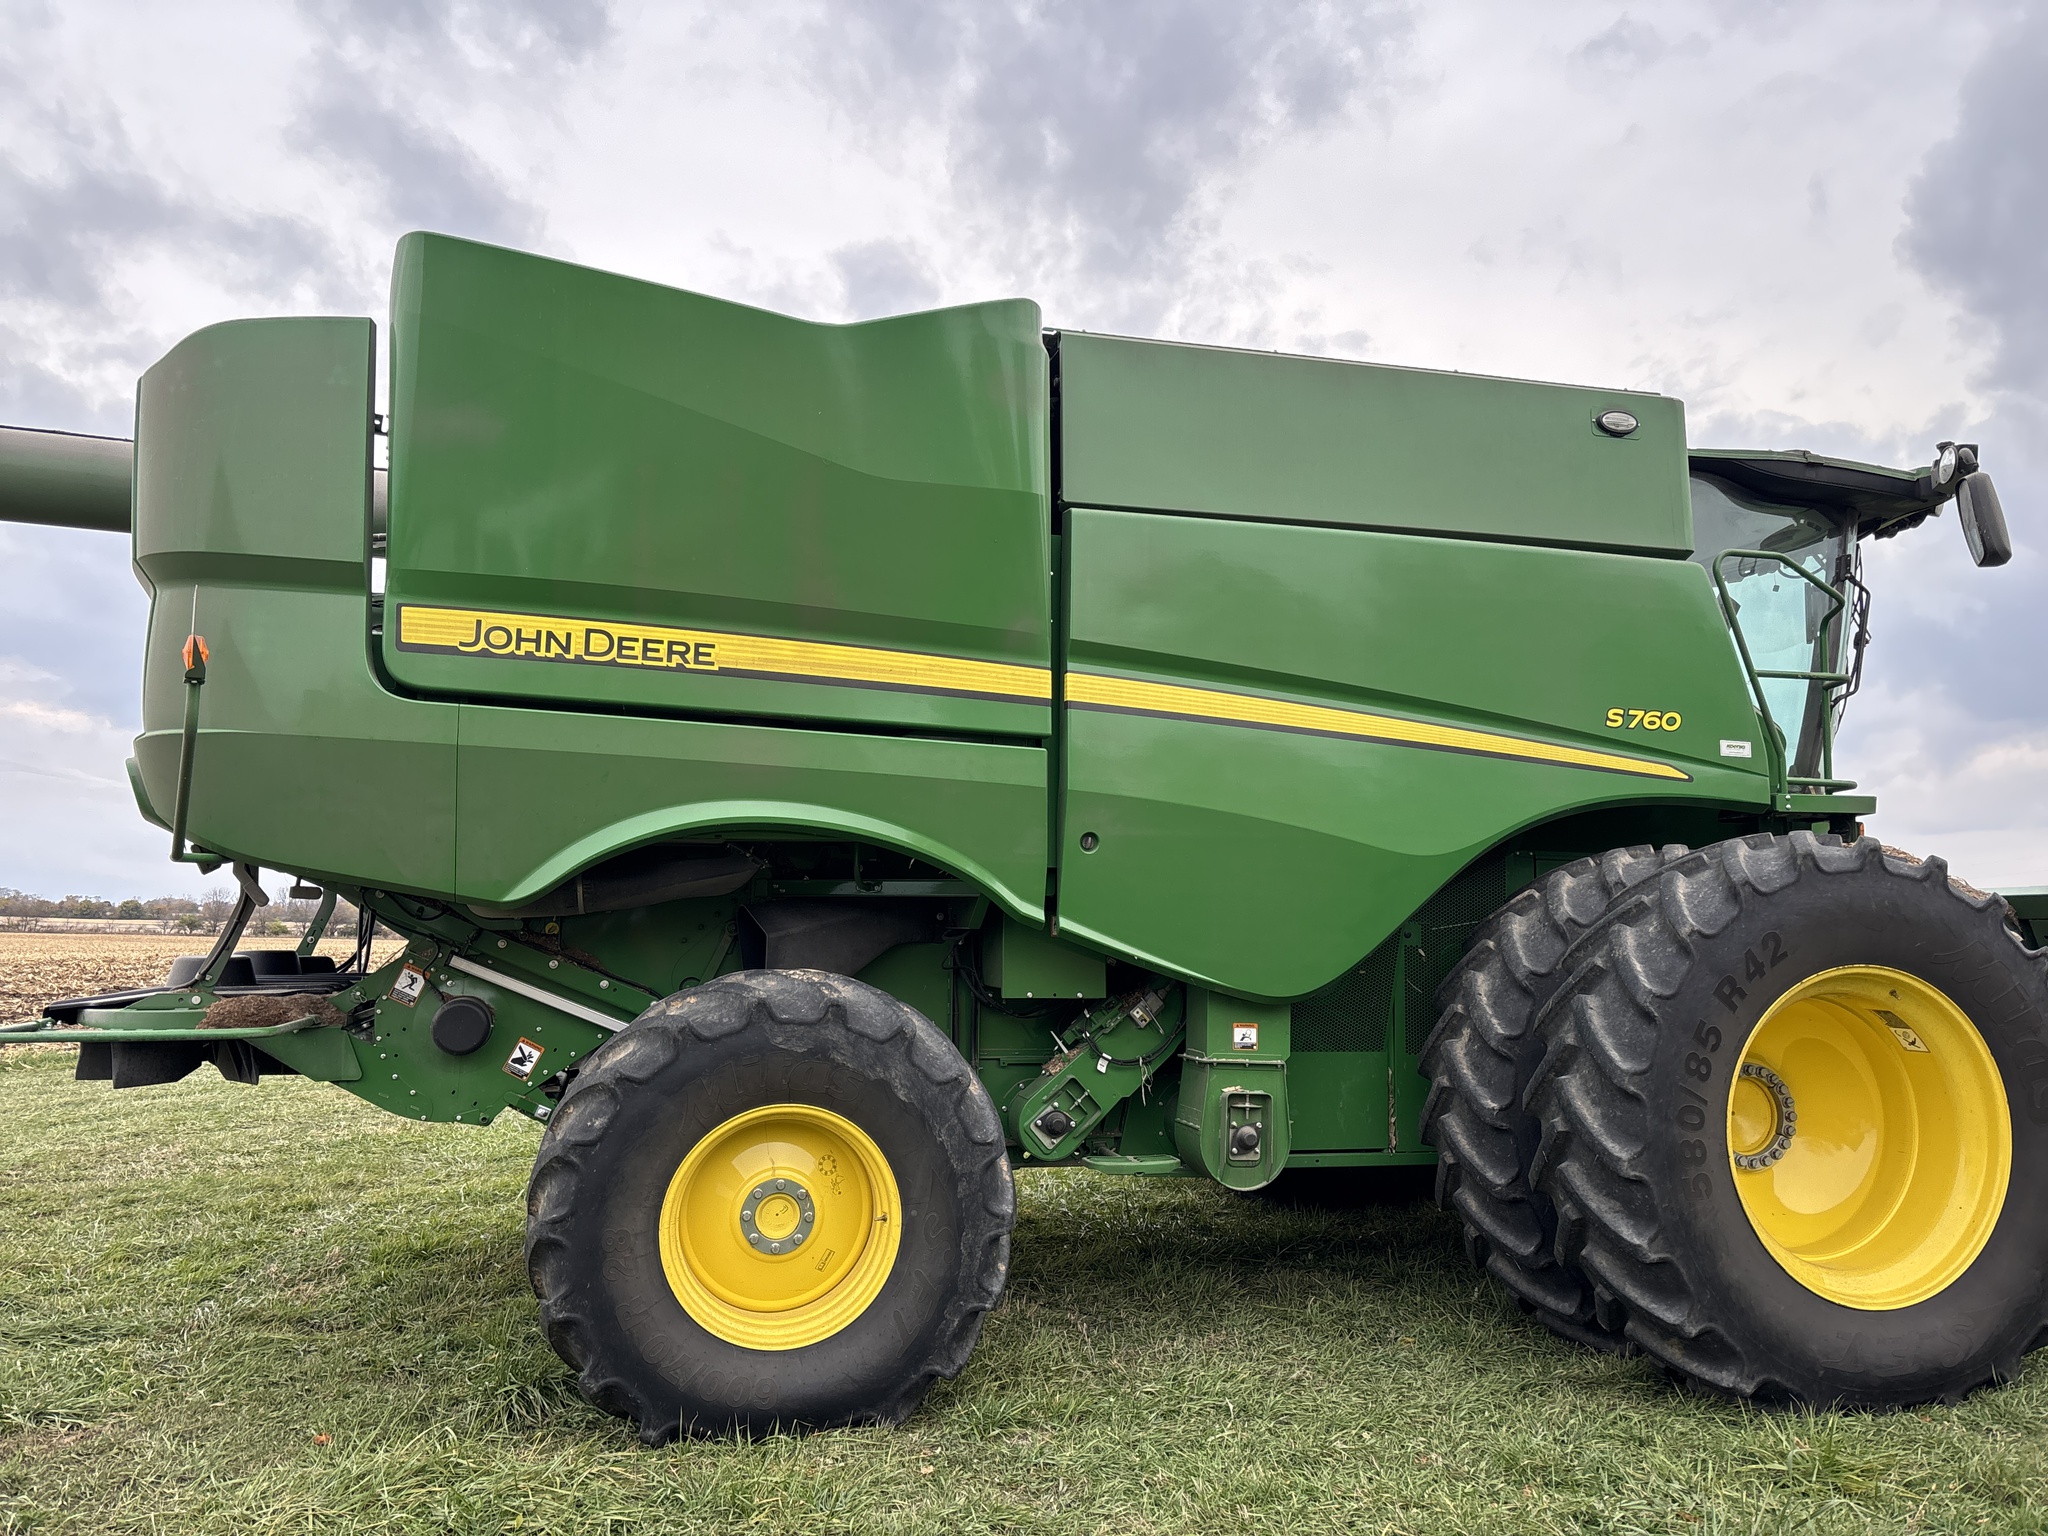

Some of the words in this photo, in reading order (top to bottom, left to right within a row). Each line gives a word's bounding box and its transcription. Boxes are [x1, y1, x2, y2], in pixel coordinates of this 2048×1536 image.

[459, 619, 572, 655] JOHN
[584, 628, 717, 667] DEERE
[679, 1051, 866, 1136] Mitas
[1675, 1019, 1723, 1201] 580/85
[641, 1333, 779, 1411] 600/70
